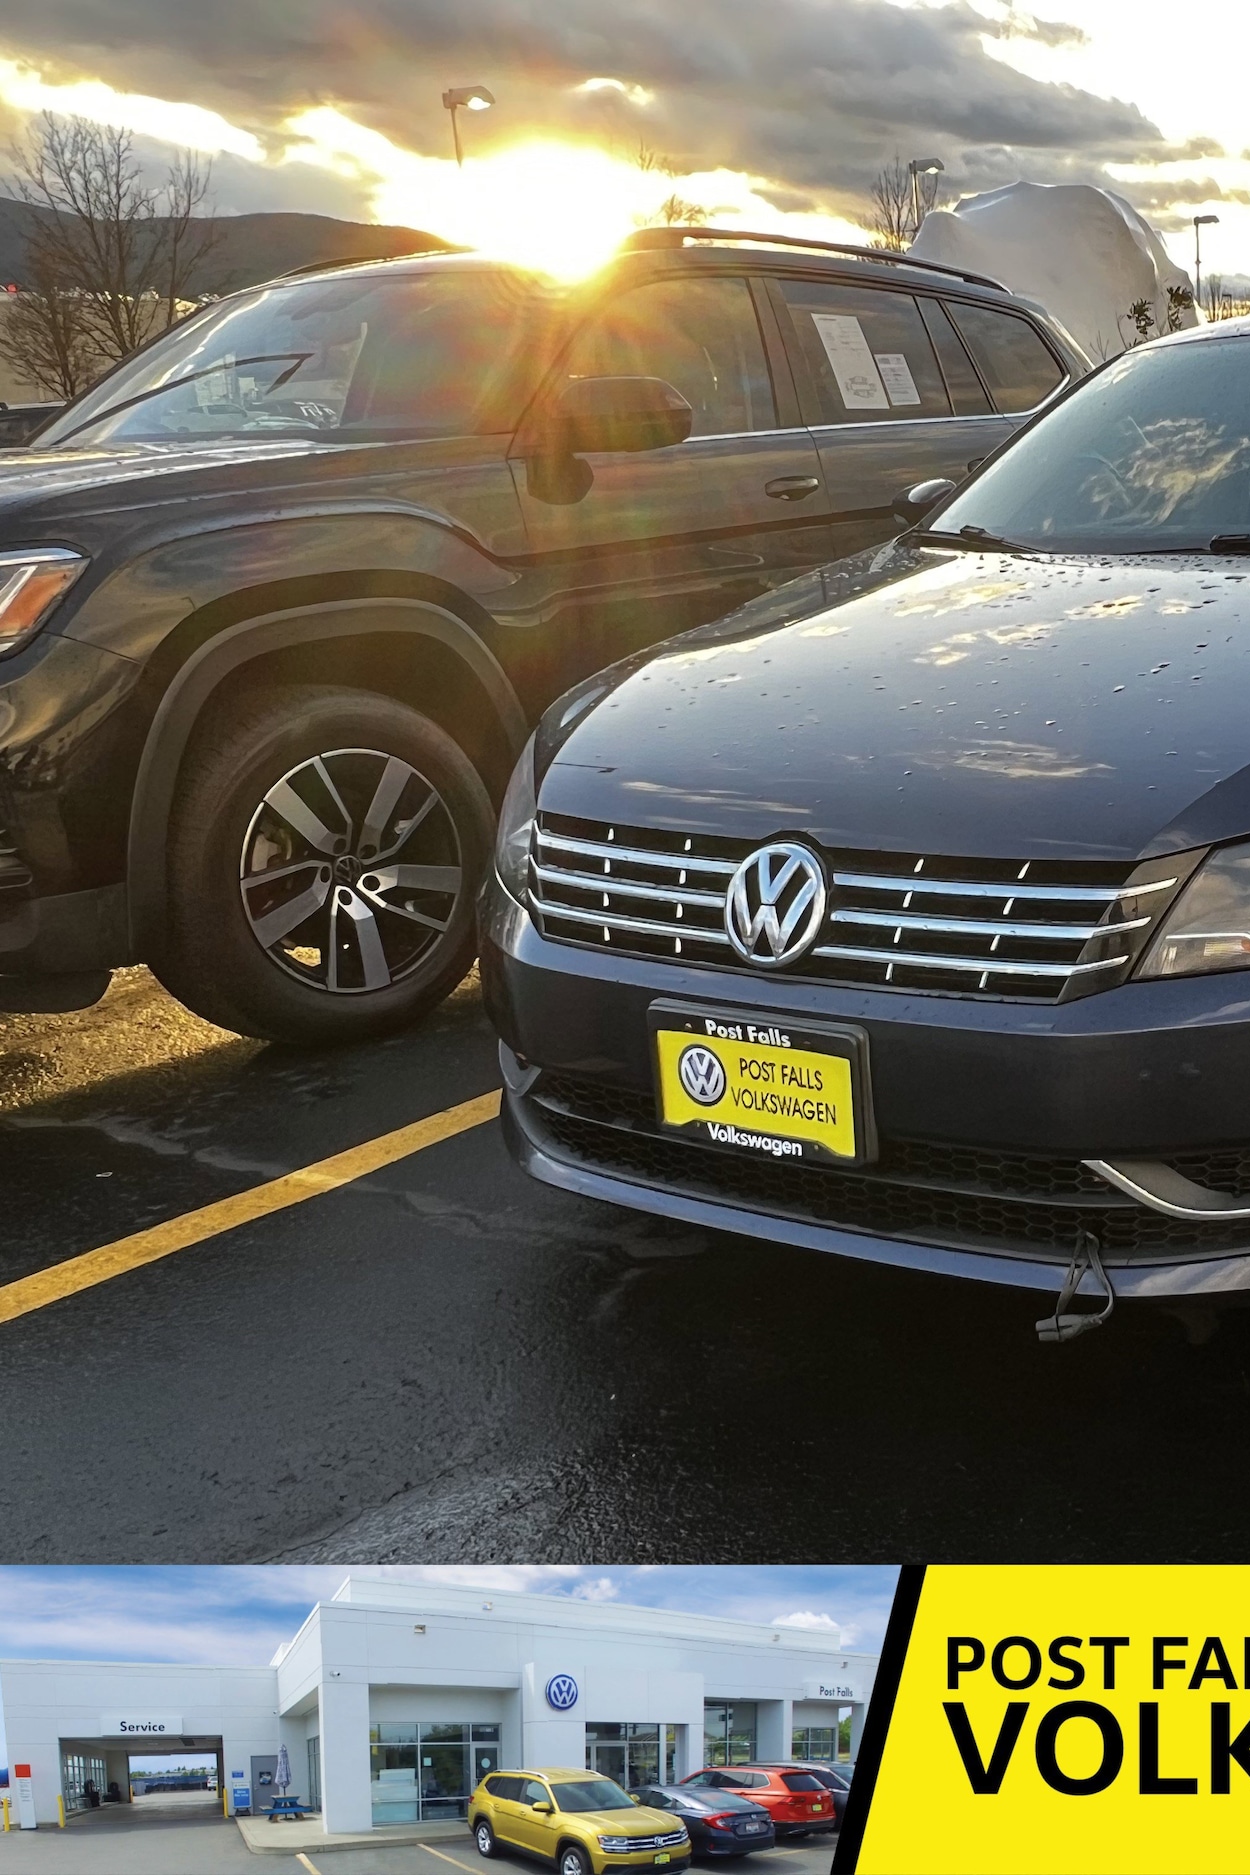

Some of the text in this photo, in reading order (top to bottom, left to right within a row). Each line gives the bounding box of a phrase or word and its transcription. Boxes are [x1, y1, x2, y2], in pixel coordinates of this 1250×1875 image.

[724, 841, 826, 967] VW
[705, 1019, 791, 1048] Post Falls
[678, 1044, 727, 1107] VW
[739, 1058, 823, 1092] POST FALLS
[731, 1086, 837, 1125] VOLKSWAGEN
[706, 1122, 802, 1157] Volkswagen
